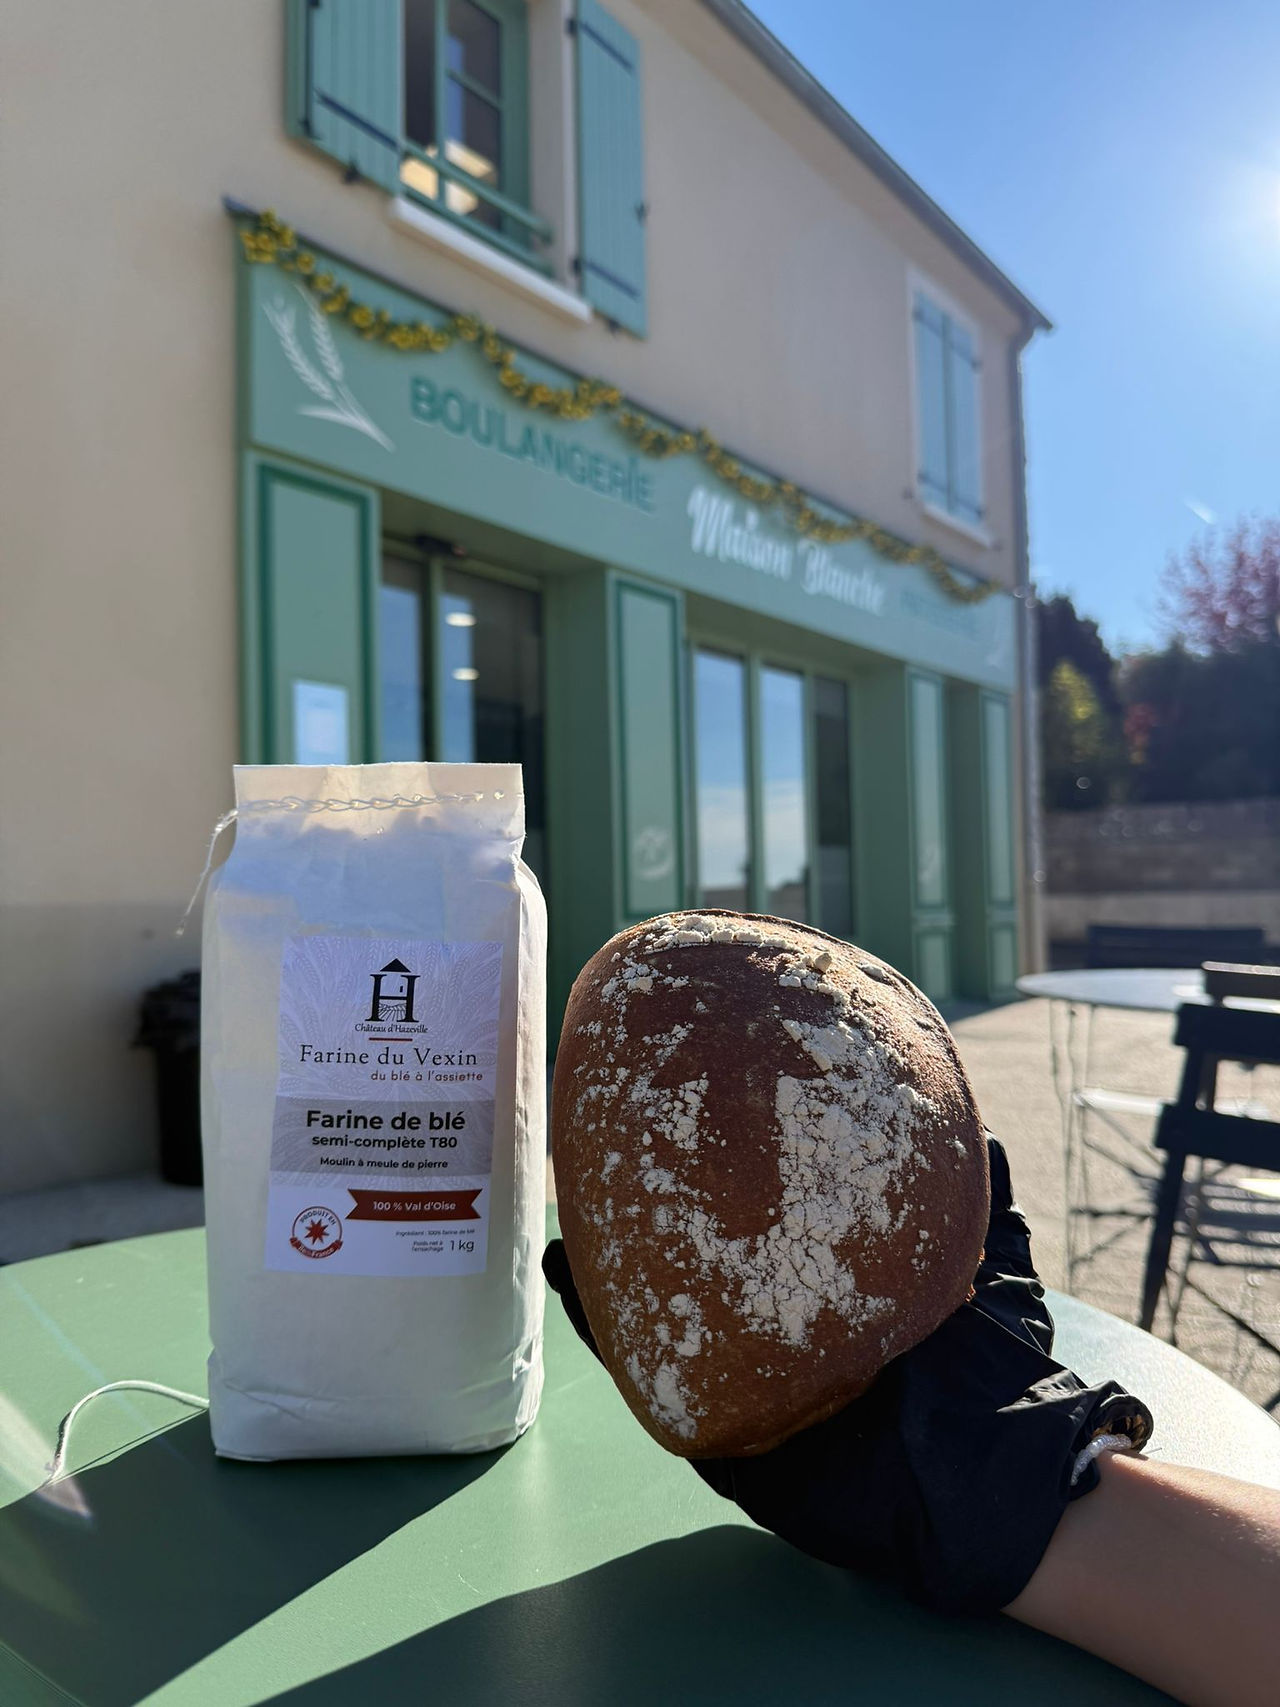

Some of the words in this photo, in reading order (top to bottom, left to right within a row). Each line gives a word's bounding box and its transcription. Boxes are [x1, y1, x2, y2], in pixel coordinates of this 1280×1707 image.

[410, 375, 656, 514] BOULANGERIE
[687, 486, 792, 582] Maison
[354, 1022, 386, 1033] Château
[387, 1023, 428, 1034] d'Hazeville
[300, 1044, 369, 1065] Farine
[377, 1046, 404, 1065] du
[412, 1047, 478, 1066] Vexin
[371, 1070, 385, 1081] du
[390, 1069, 411, 1081] blé
[415, 1070, 423, 1082] à
[427, 1070, 484, 1082] l'assiette
[306, 1110, 384, 1130] Farine
[390, 1112, 422, 1131] de
[429, 1111, 466, 1131] blé
[311, 1134, 426, 1151] semi-complète
[429, 1136, 458, 1149] T80
[320, 1157, 355, 1167] Moulin
[358, 1157, 364, 1167] à
[366, 1158, 399, 1169] meule
[401, 1159, 415, 1169] de
[417, 1159, 448, 1170] pierre
[373, 1200, 391, 1211] 100
[392, 1201, 402, 1211] %
[404, 1200, 422, 1211] Val
[423, 1200, 456, 1211] d'Oise
[450, 1240, 455, 1251] 1
[458, 1240, 475, 1253] kg
